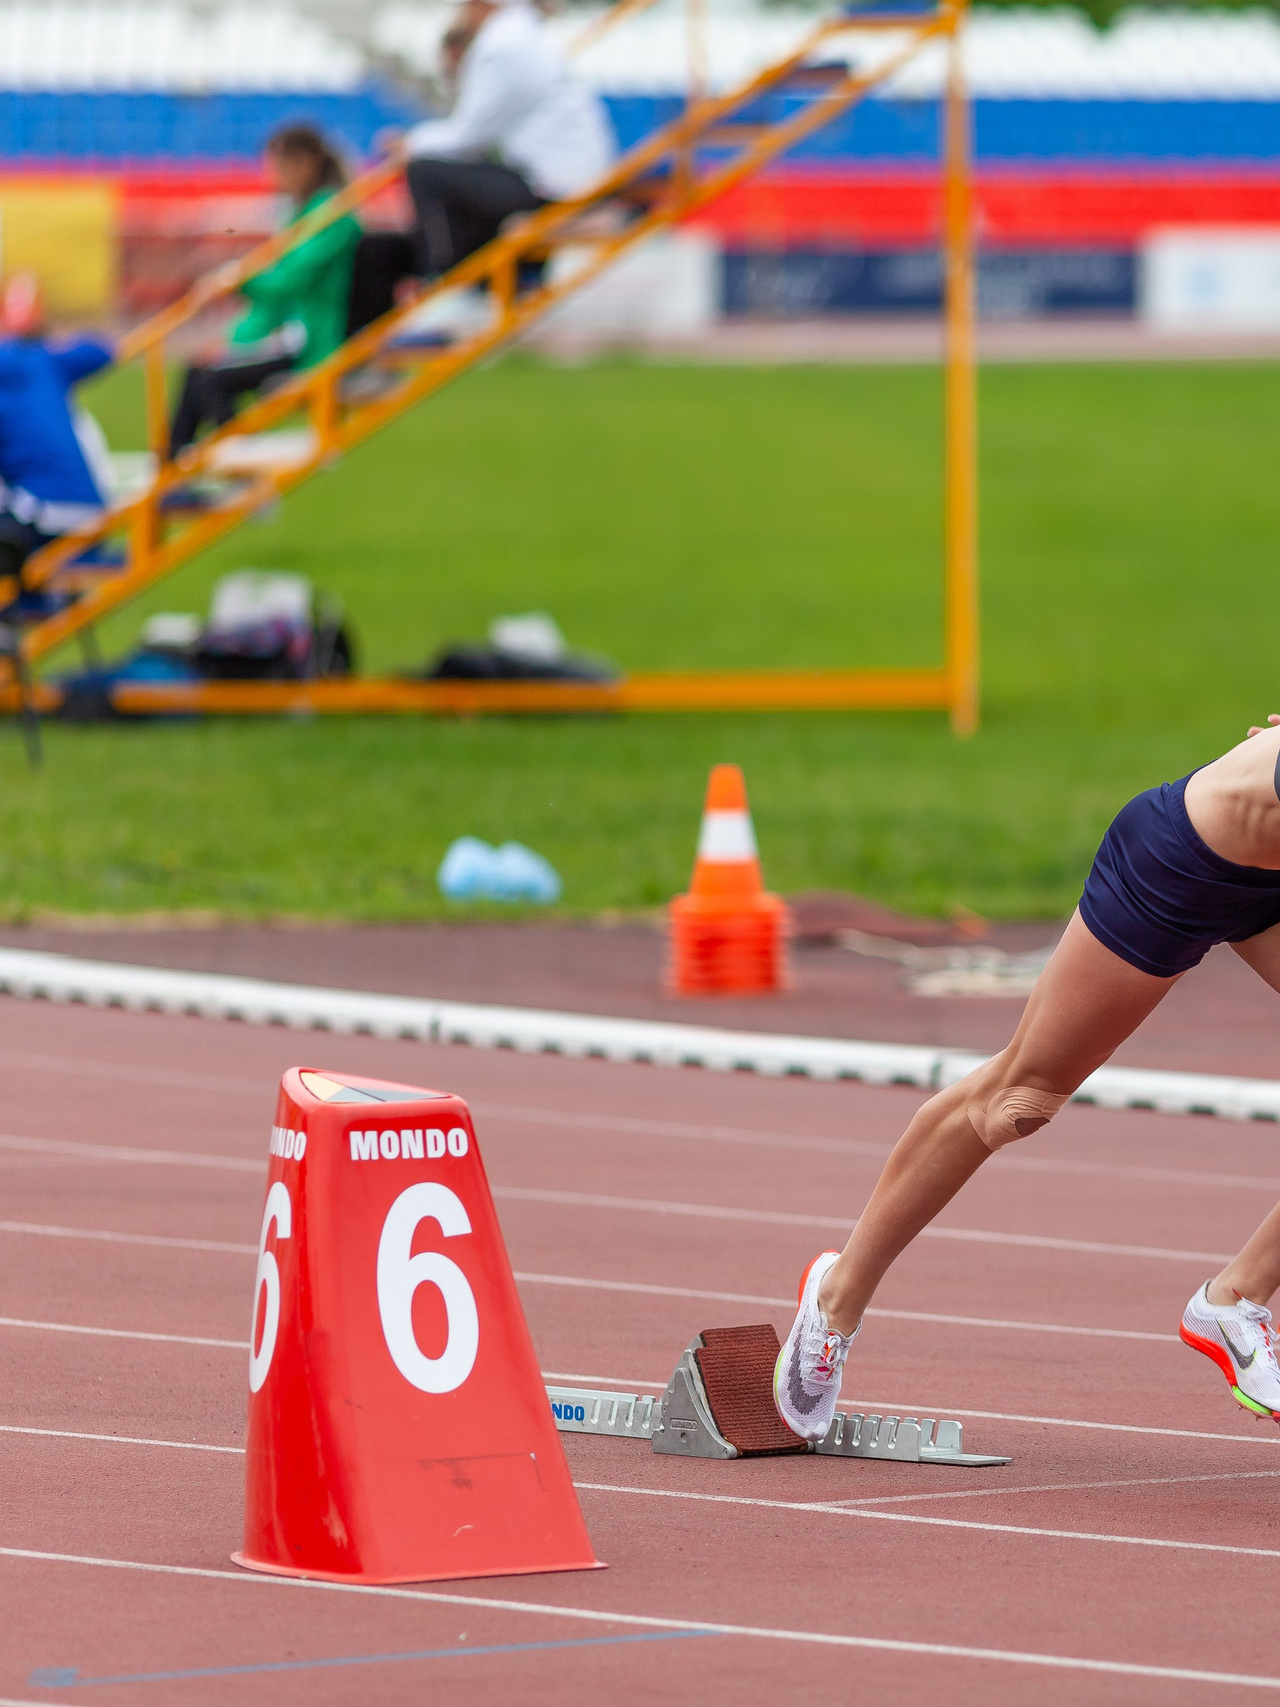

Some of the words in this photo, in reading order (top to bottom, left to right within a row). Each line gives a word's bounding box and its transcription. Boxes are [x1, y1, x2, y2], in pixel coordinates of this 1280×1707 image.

[349, 1127, 469, 1161] MONDO
[249, 1181, 292, 1393] 6
[376, 1181, 480, 1394] 6
[551, 1403, 585, 1422] NDO
